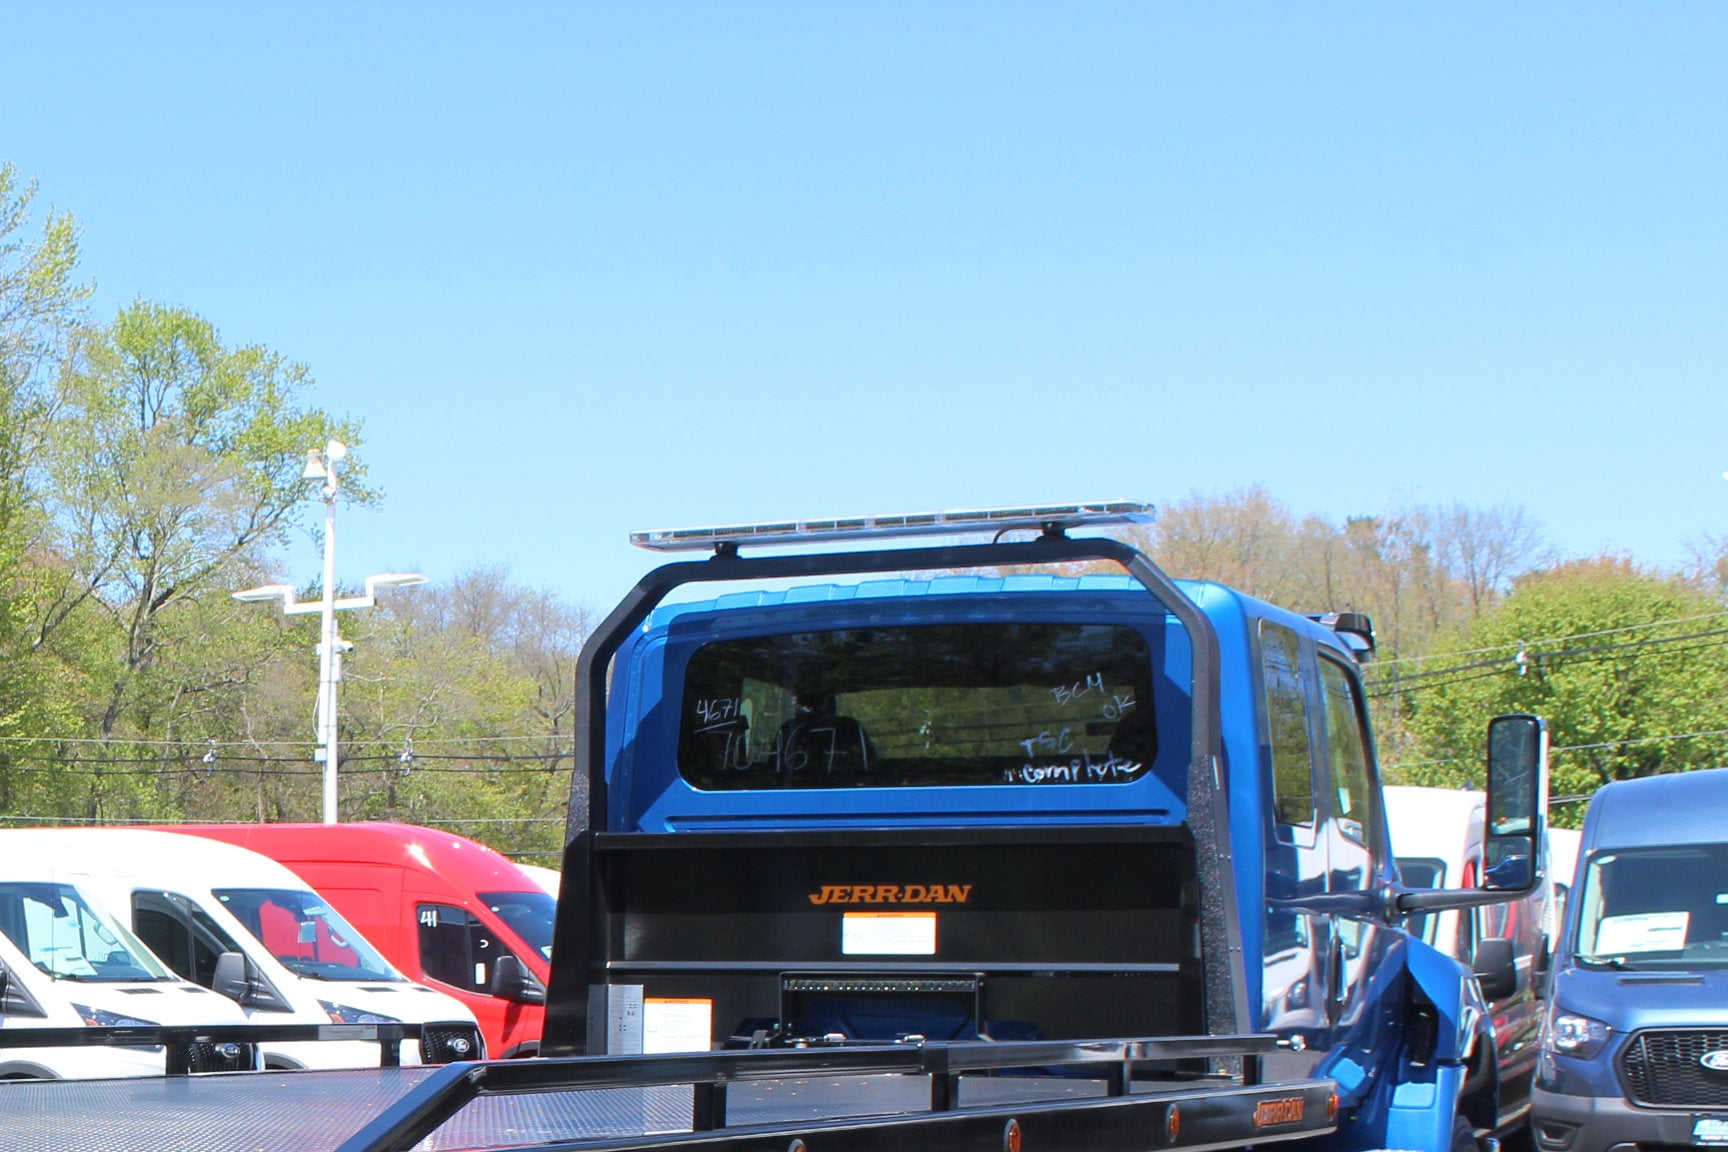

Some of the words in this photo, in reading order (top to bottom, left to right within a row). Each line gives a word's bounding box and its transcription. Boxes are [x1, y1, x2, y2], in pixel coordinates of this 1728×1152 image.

[1050, 672, 1105, 706] BCM
[696, 697, 740, 724] 4671
[1102, 695, 1136, 719] OK
[420, 910, 438, 928] 41
